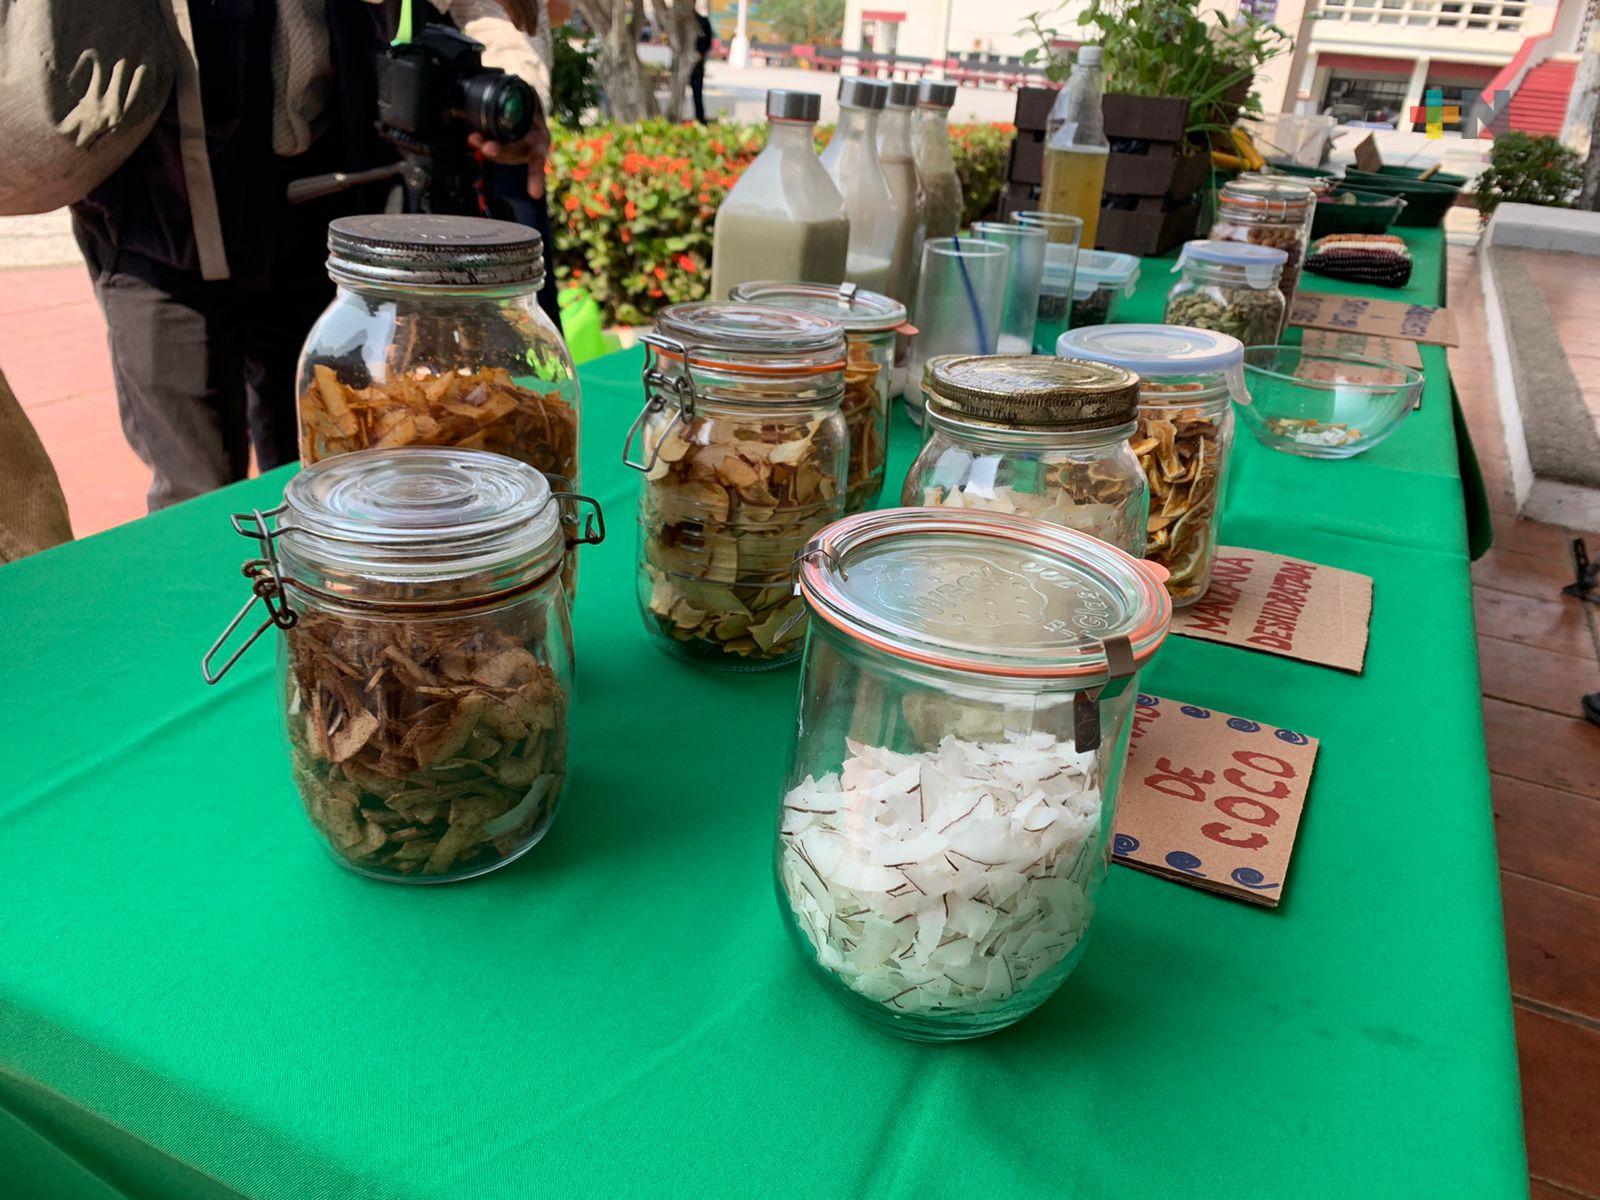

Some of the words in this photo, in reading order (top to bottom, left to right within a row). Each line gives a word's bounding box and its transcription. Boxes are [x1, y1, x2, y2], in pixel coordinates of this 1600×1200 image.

[1184, 556, 1255, 636] MANZANA
[1143, 756, 1217, 802] DE
[1200, 750, 1298, 851] COCO
